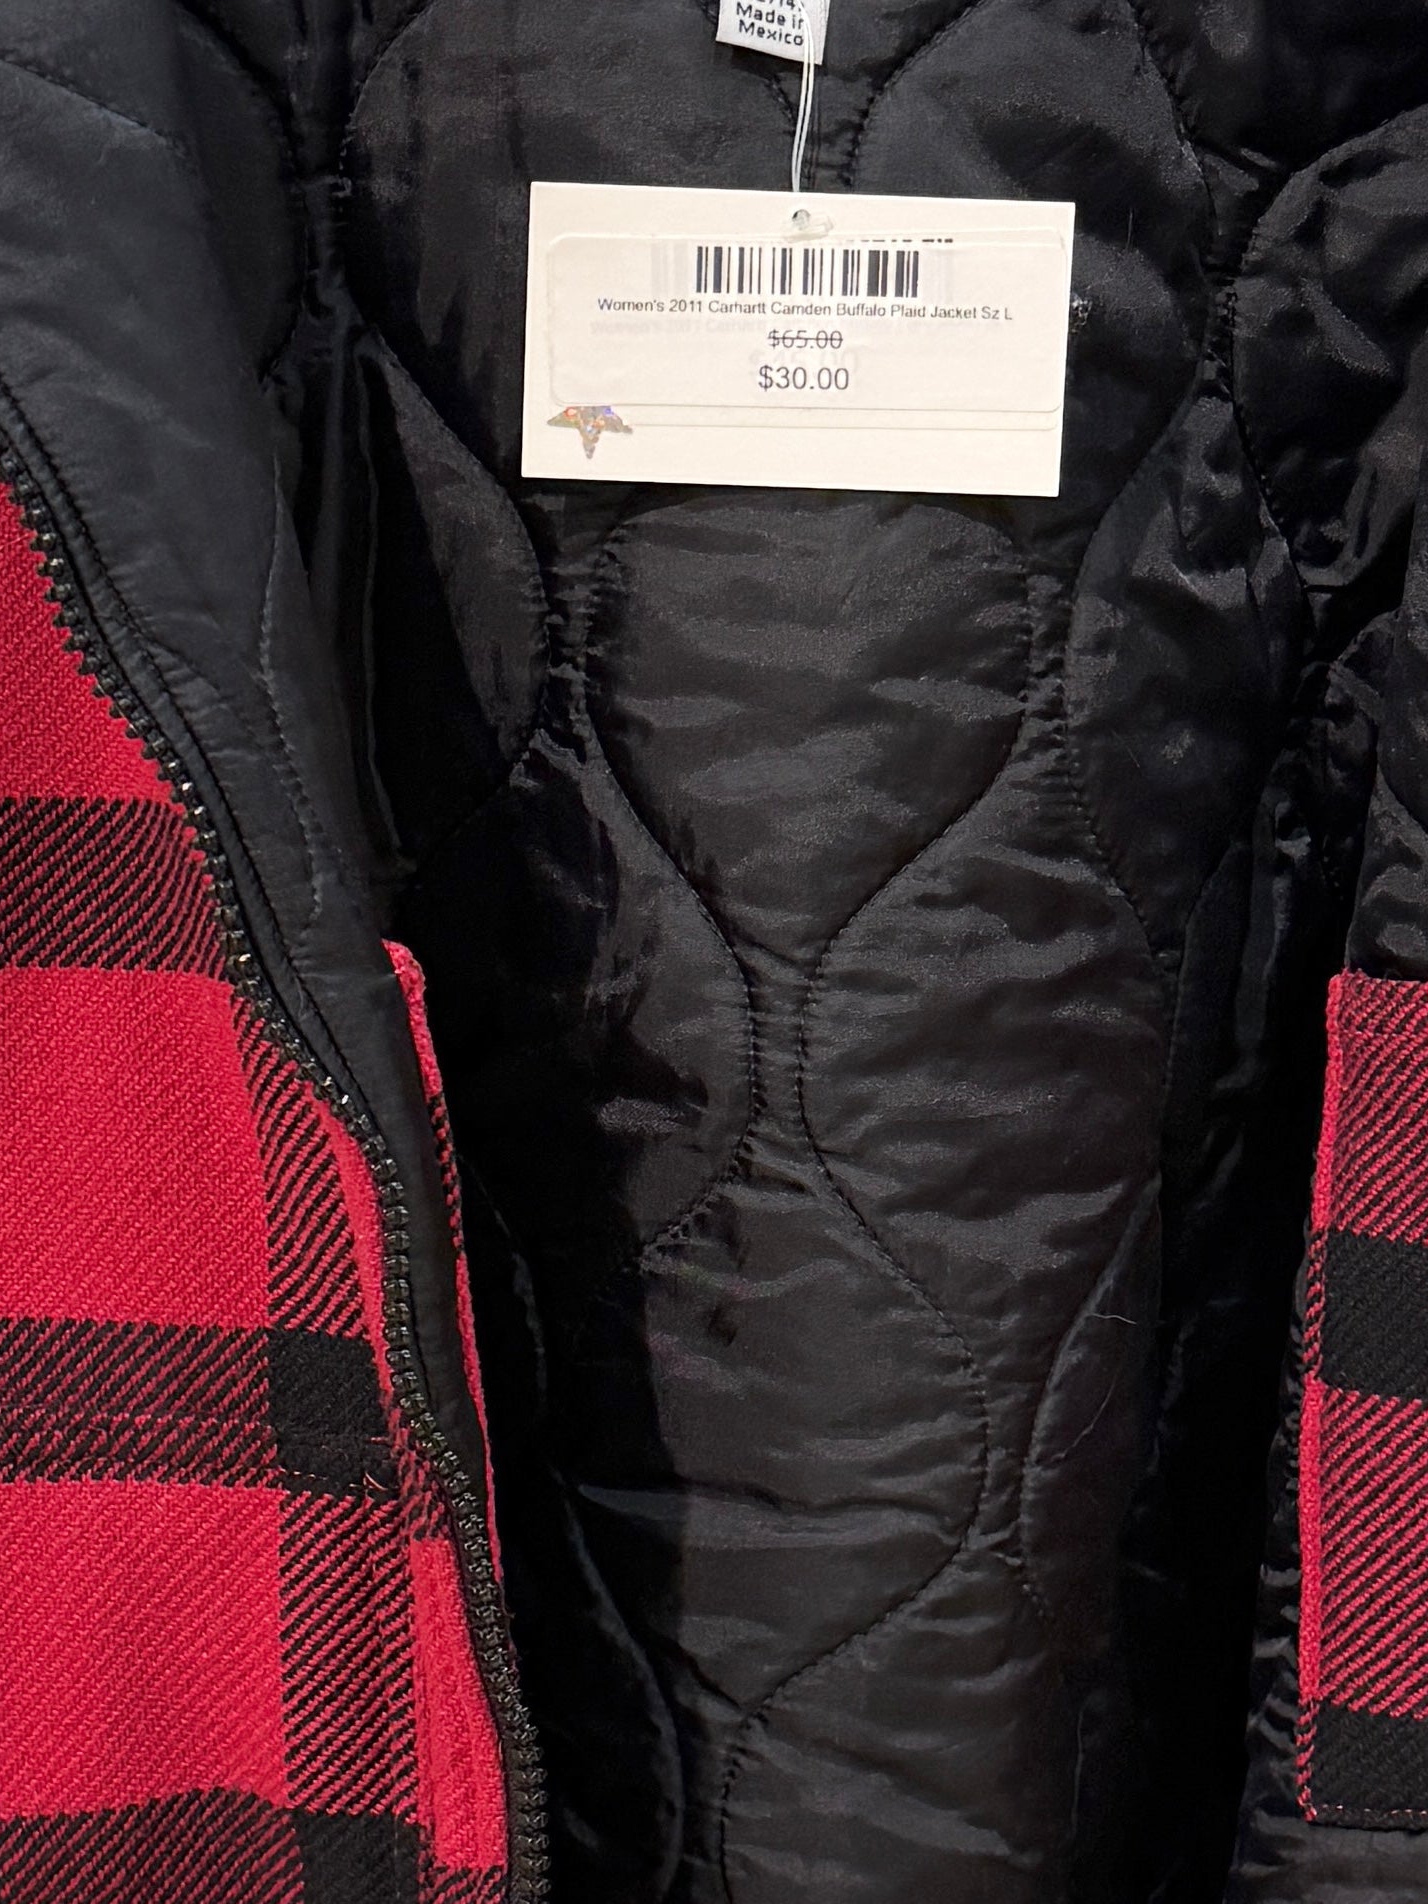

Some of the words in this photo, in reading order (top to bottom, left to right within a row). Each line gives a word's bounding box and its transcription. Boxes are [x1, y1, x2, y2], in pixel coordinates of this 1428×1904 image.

[736, 1, 786, 26] Made
[739, 19, 804, 46] Mexico
[598, 298, 664, 313] Women's
[669, 298, 703, 313] 2011
[708, 300, 766, 315] Carhartt
[771, 301, 831, 316] Camden
[836, 302, 886, 317] Buffalo
[891, 304, 926, 318] Plaid
[930, 305, 977, 319] Jacket
[981, 306, 1000, 320] Sz
[1004, 306, 1013, 320] L
[768, 329, 844, 350] $65.00
[758, 365, 850, 391] $30.00
